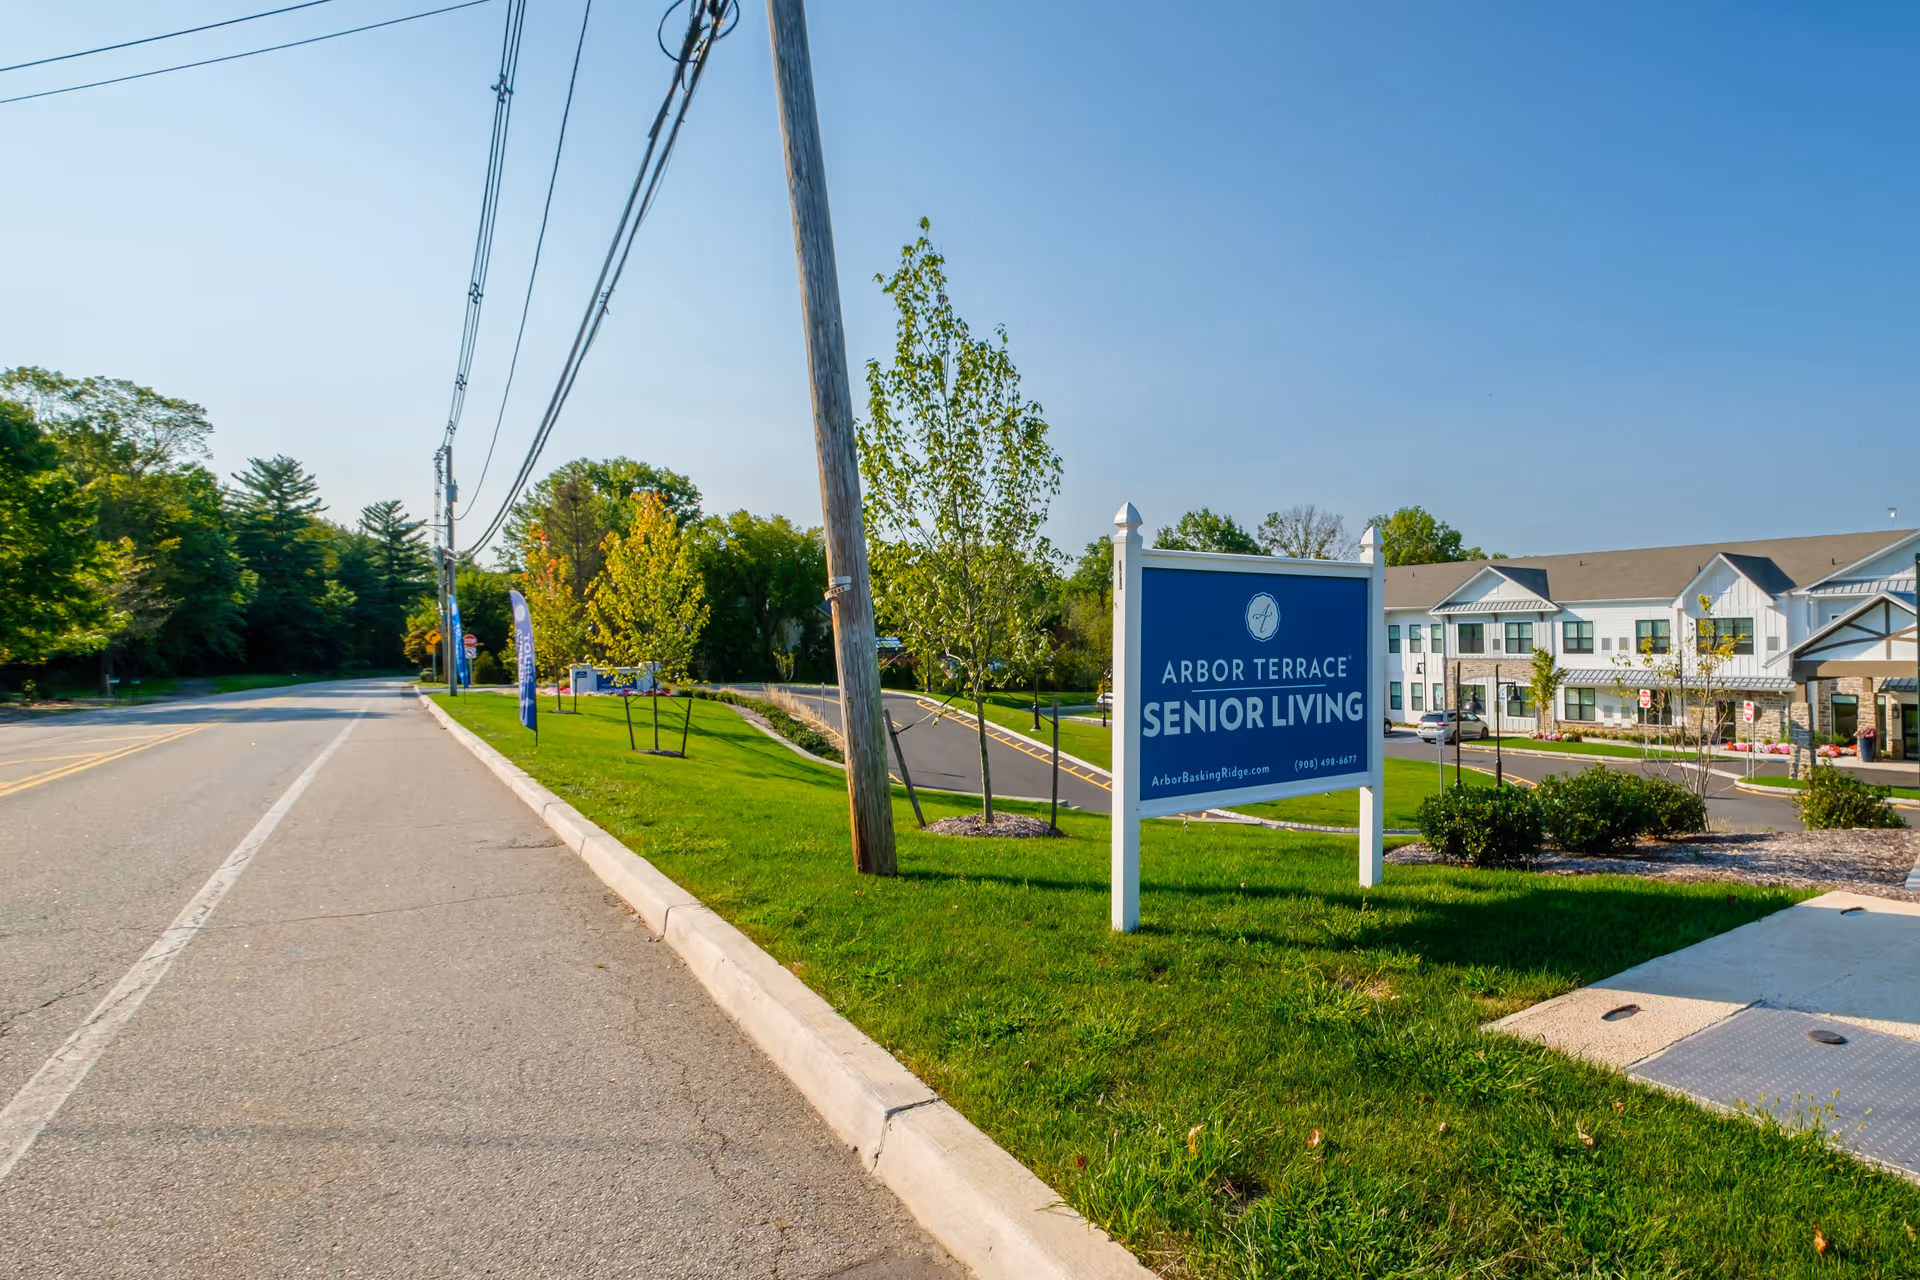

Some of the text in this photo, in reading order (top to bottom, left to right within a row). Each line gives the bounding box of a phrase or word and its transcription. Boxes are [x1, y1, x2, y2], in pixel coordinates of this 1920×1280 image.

[1161, 657, 1347, 684] ARBOR TERRACE
[1142, 692, 1364, 737] SENIOR LIVING
[1294, 755, 1357, 772] (908) 498-6677
[1151, 765, 1270, 787] ArborBaskingRidge.com
